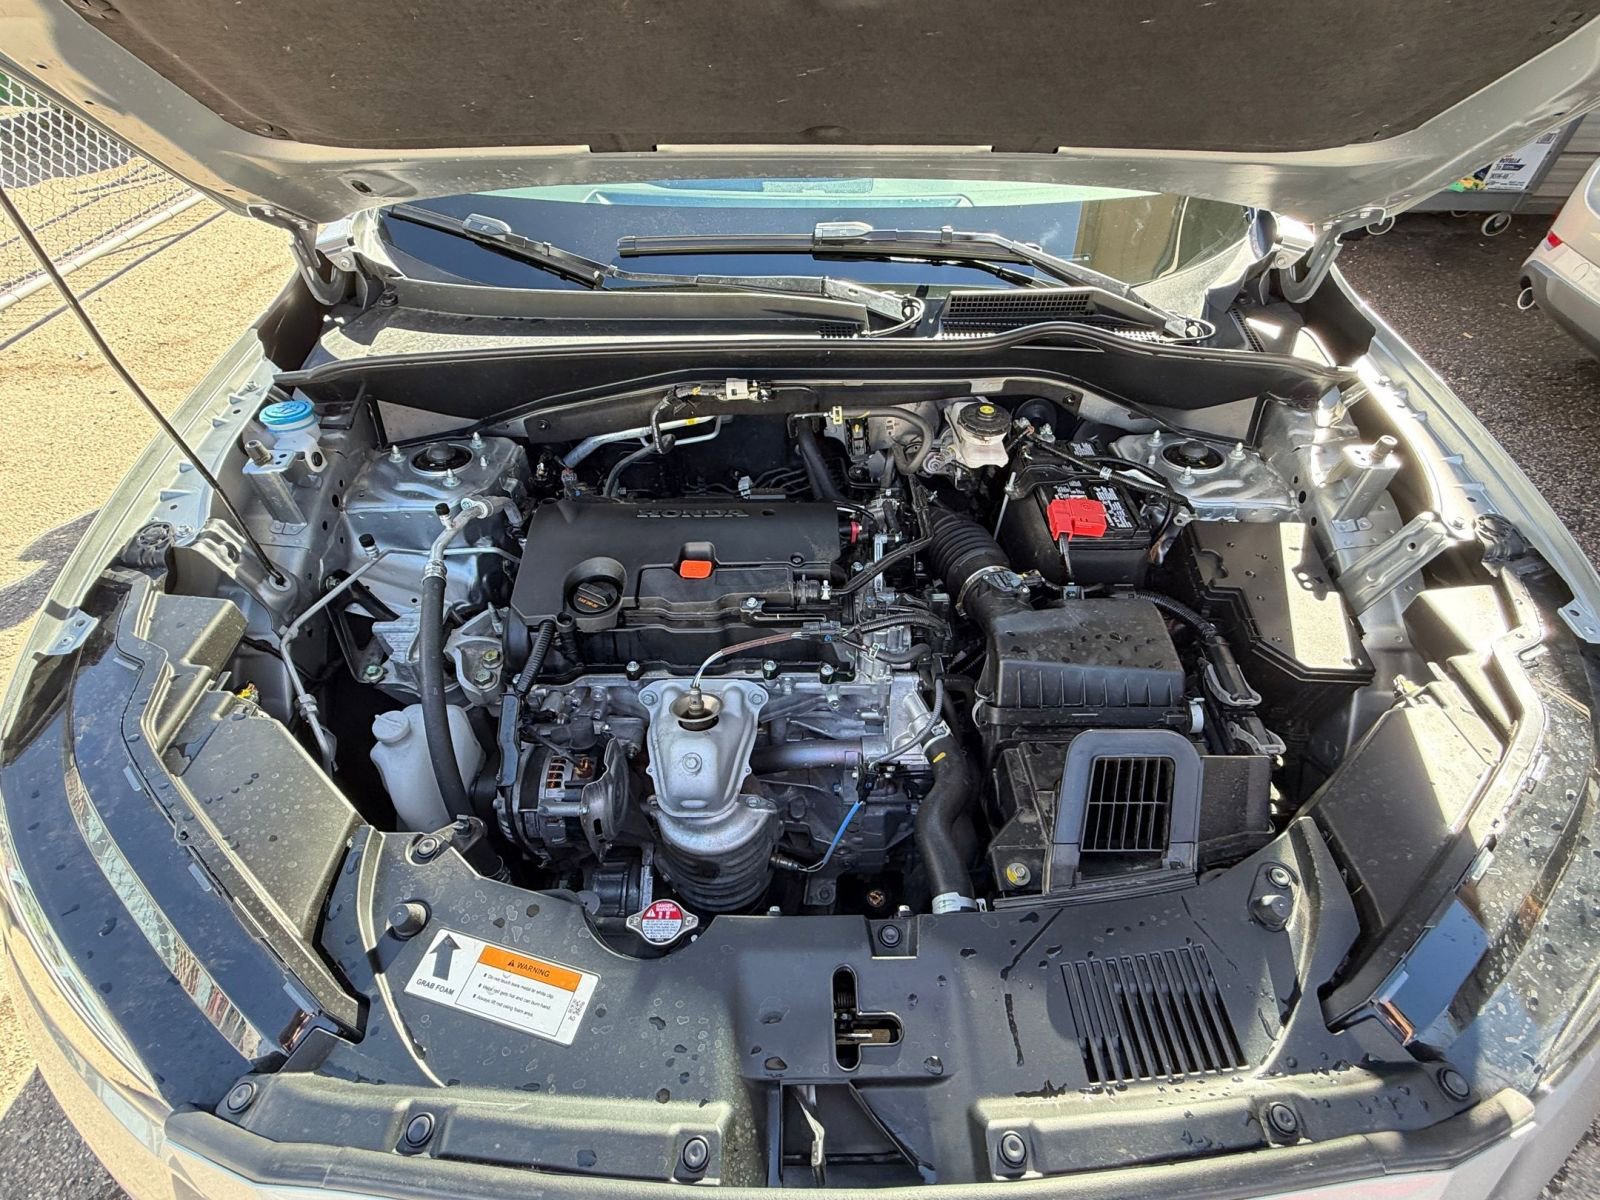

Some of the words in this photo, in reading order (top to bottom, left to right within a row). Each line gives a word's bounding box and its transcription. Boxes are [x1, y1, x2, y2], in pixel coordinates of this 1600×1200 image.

[636, 508, 749, 518] HONDA
[516, 962, 551, 978] WARNING
[416, 978, 435, 989] GRAB
[434, 984, 455, 996] FOAM
